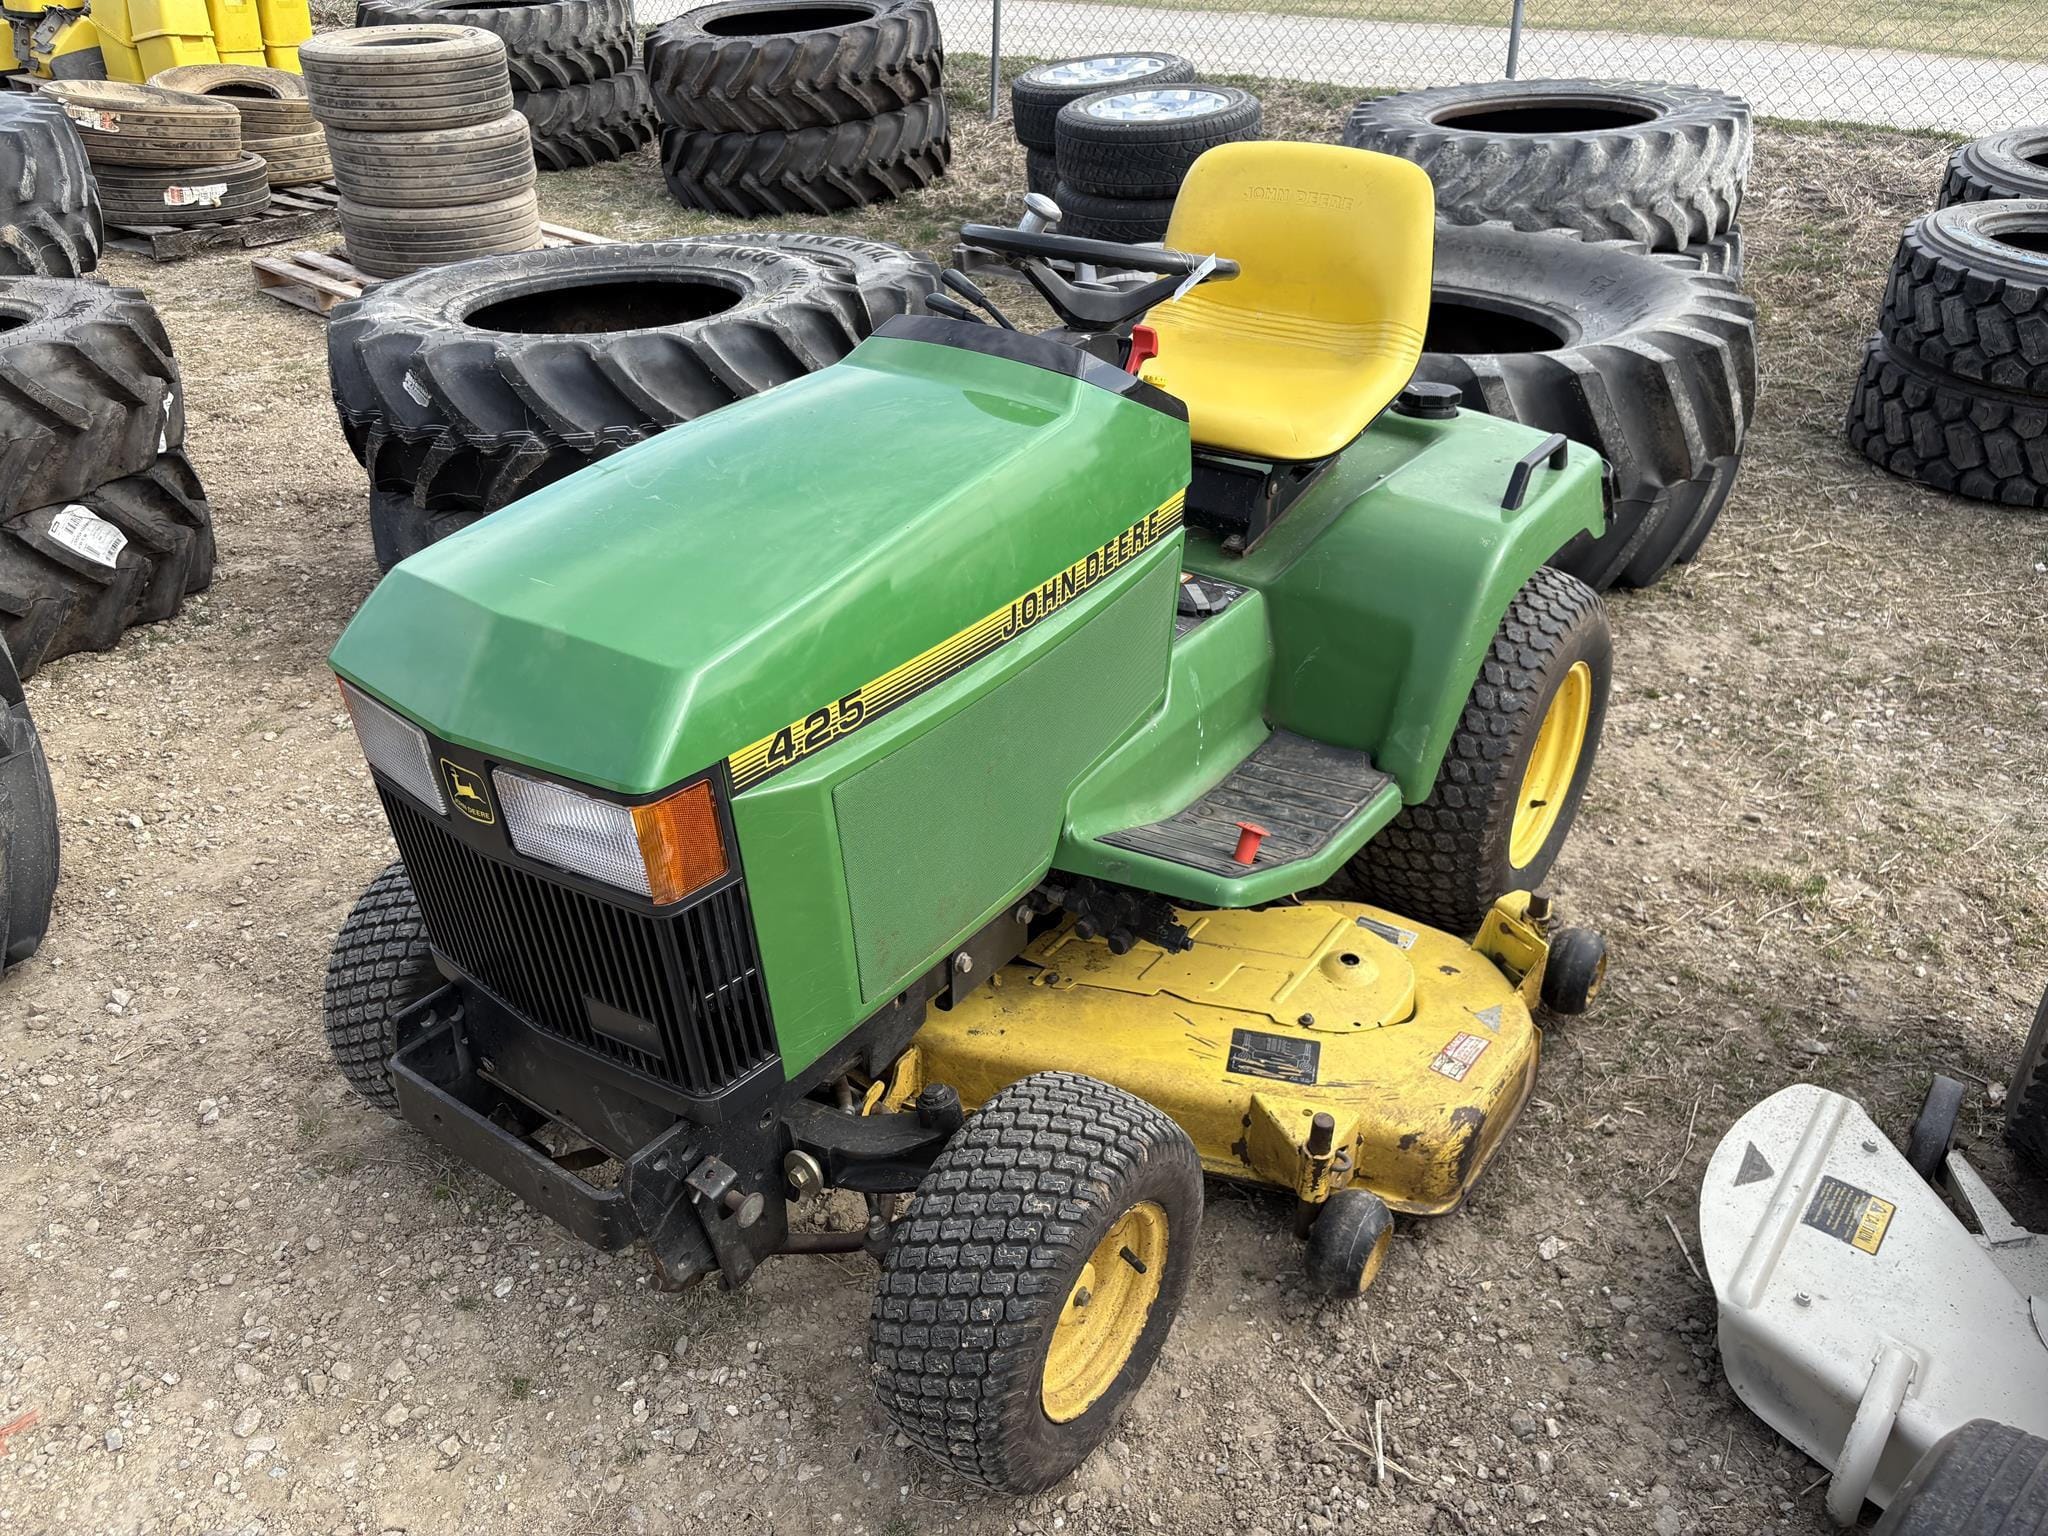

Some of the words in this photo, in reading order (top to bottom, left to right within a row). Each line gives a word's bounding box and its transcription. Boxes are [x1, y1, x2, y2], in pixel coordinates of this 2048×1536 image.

[1243, 186, 1290, 203] JOHN
[1296, 189, 1355, 211] DEERE
[499, 243, 710, 271] CONTRACT
[1001, 565, 1078, 639] JOHN
[1085, 509, 1161, 588] DEERE
[766, 687, 865, 764] 425
[466, 806, 491, 820] DEERE
